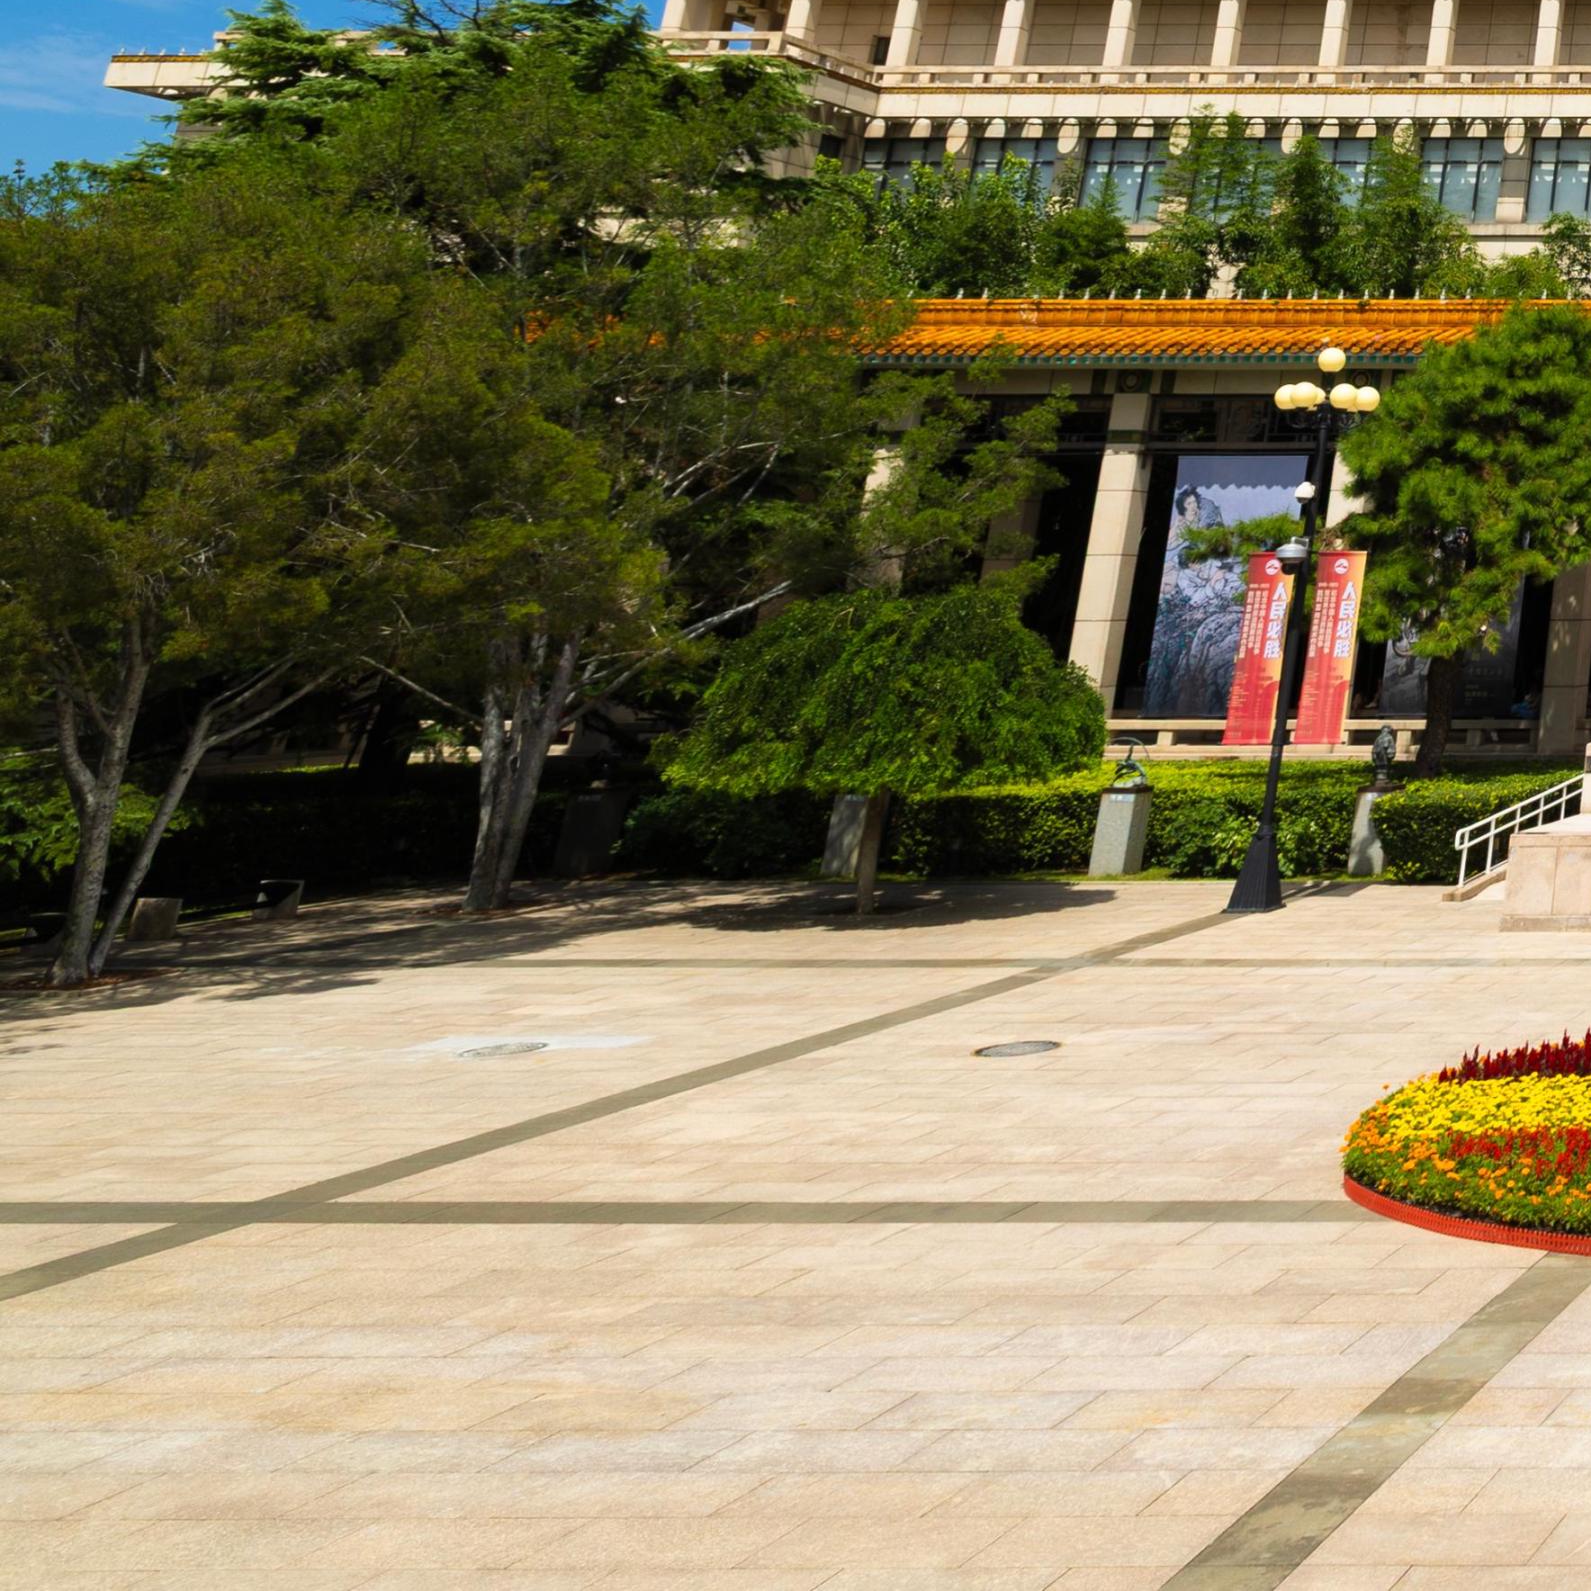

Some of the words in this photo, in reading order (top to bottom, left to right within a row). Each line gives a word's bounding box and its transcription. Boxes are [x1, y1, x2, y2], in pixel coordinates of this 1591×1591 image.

[1263, 581, 1288, 658] 人民必胜
[1333, 581, 1357, 658] 人民必胜
